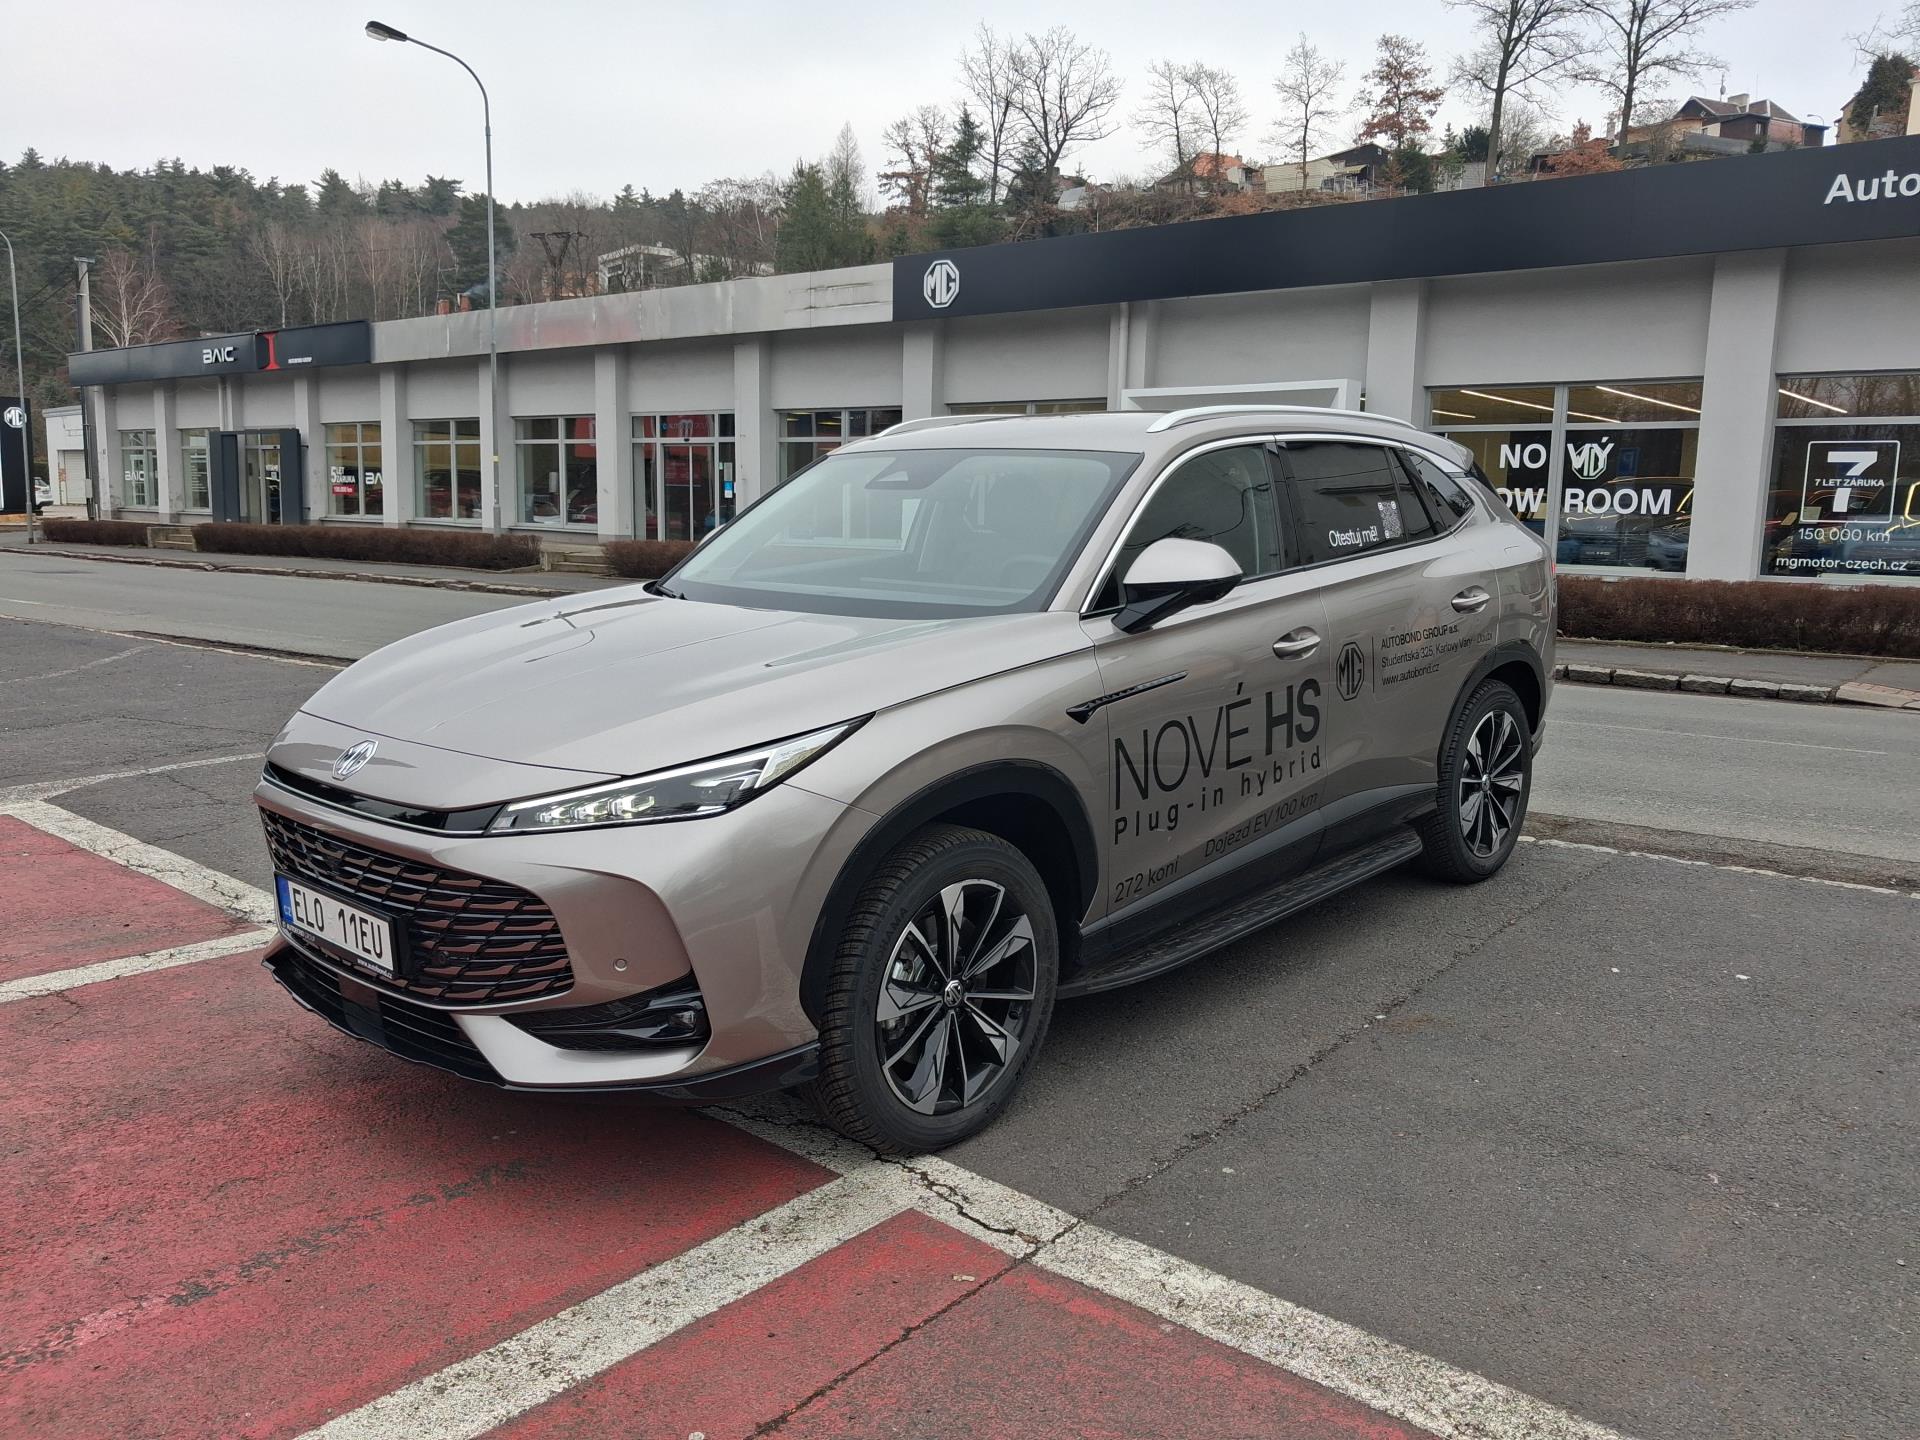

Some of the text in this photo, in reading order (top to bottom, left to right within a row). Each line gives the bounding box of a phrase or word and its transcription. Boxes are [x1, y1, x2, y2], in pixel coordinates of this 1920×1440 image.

[1823, 169, 1920, 205] Auto
[926, 262, 957, 306] MG
[202, 346, 235, 364] BAIC
[1814, 477, 1885, 487] 7 LET ZÁRUKA
[1564, 487, 1672, 515] ROOM
[1328, 525, 1380, 547] Otestuj mě!
[1798, 527, 1891, 543] 150 000 km
[1775, 556, 1908, 571] mgmotor-czech.cz
[1381, 630, 1422, 650] AUTOBOND
[1423, 624, 1449, 641] GROUP
[1381, 649, 1420, 669] Studentská
[1435, 641, 1459, 656] Karlovy
[1337, 645, 1363, 698] MG
[1381, 663, 1440, 686] www.autobond.cz
[1114, 677, 1321, 811] NOVÉ HS
[1114, 745, 1321, 845] Plug-in hybrid
[1203, 820, 1251, 858] Dojezd
[1253, 809, 1274, 834] EV
[1275, 798, 1298, 823] 100
[1114, 872, 1144, 904] 272
